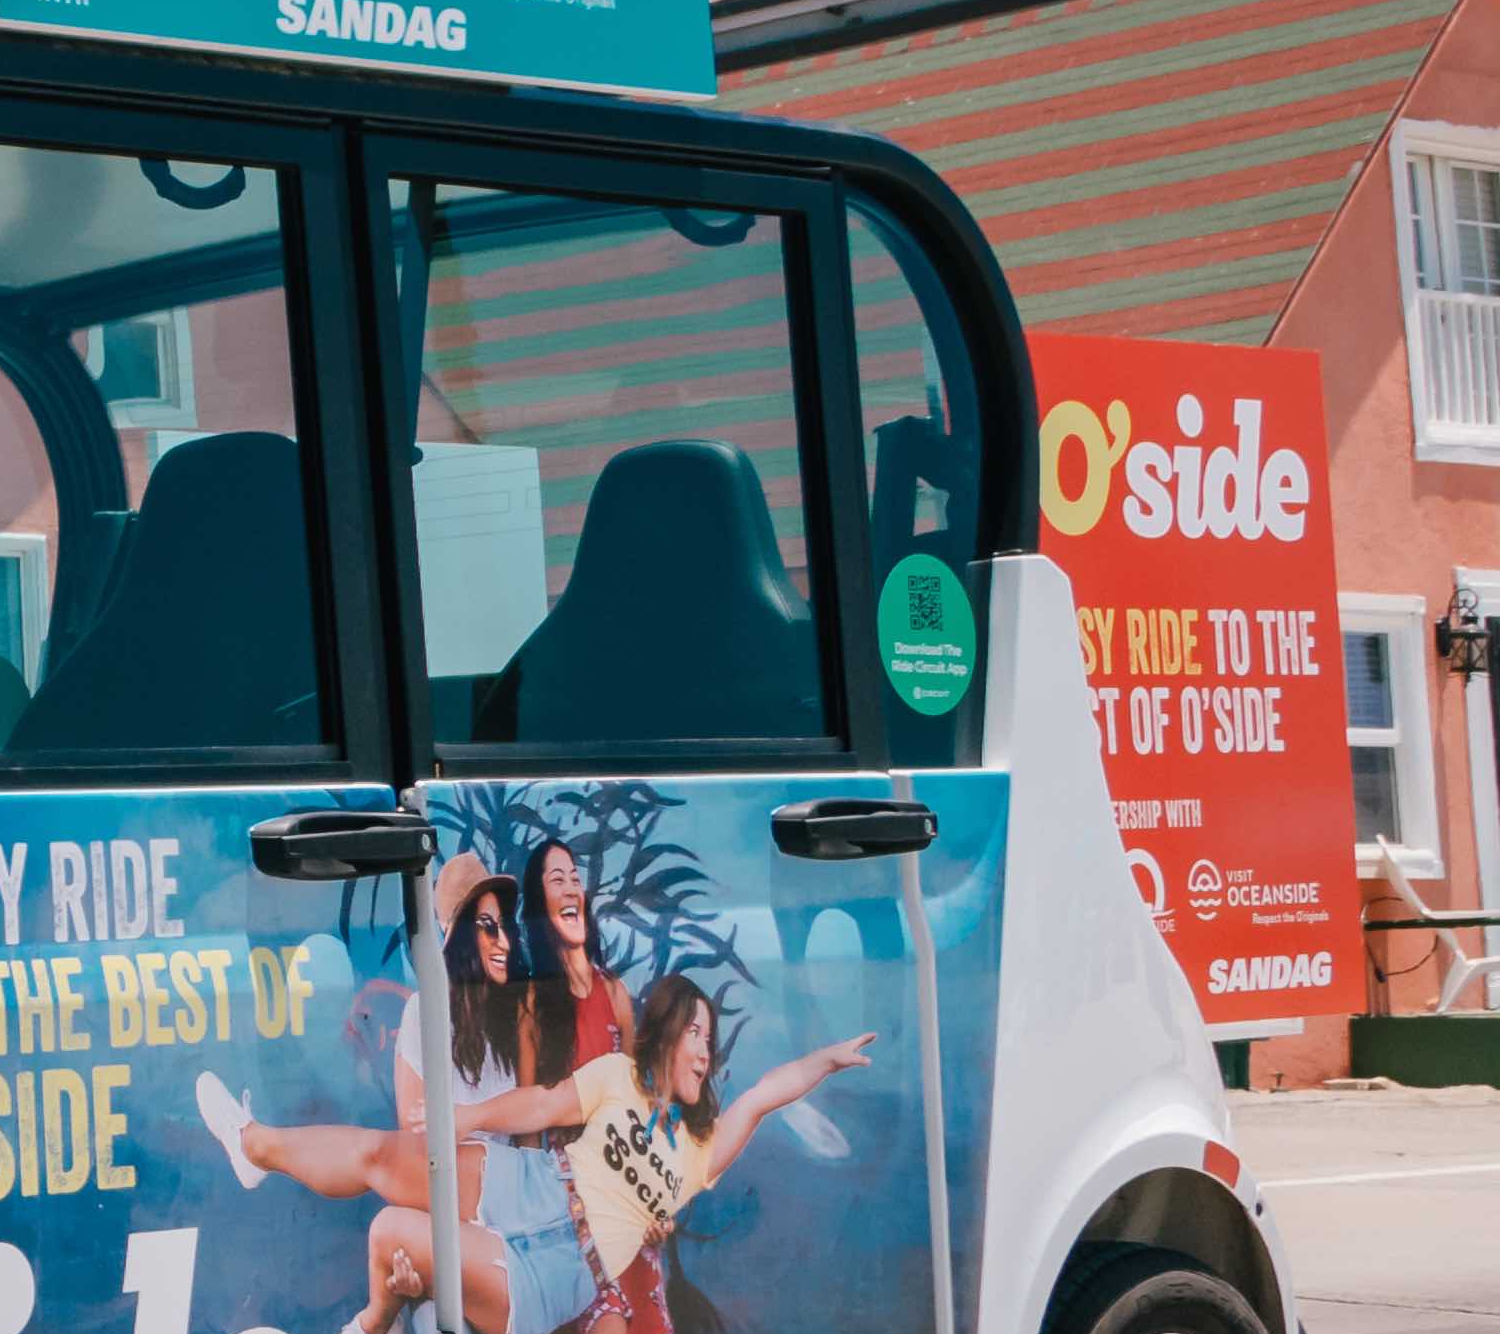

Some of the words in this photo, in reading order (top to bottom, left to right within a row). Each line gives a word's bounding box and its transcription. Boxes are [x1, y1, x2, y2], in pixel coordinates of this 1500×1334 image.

[1076, 606, 1116, 676] SY
[1126, 608, 1202, 676] RIDE
[1208, 609, 1250, 676] TO
[1256, 609, 1320, 676] THE
[1129, 686, 1170, 755] OF
[1180, 686, 1285, 754] O'SIDE
[1111, 799, 1162, 830] ERSHIP
[1164, 799, 1202, 828] WITH
[49, 838, 185, 942] RIDE
[1226, 869, 1254, 884] VISIT
[1227, 882, 1320, 907] OCEANSIDE
[100, 949, 233, 1049] BEST
[249, 945, 314, 1040] OF
[1208, 951, 1332, 995] SANDAG
